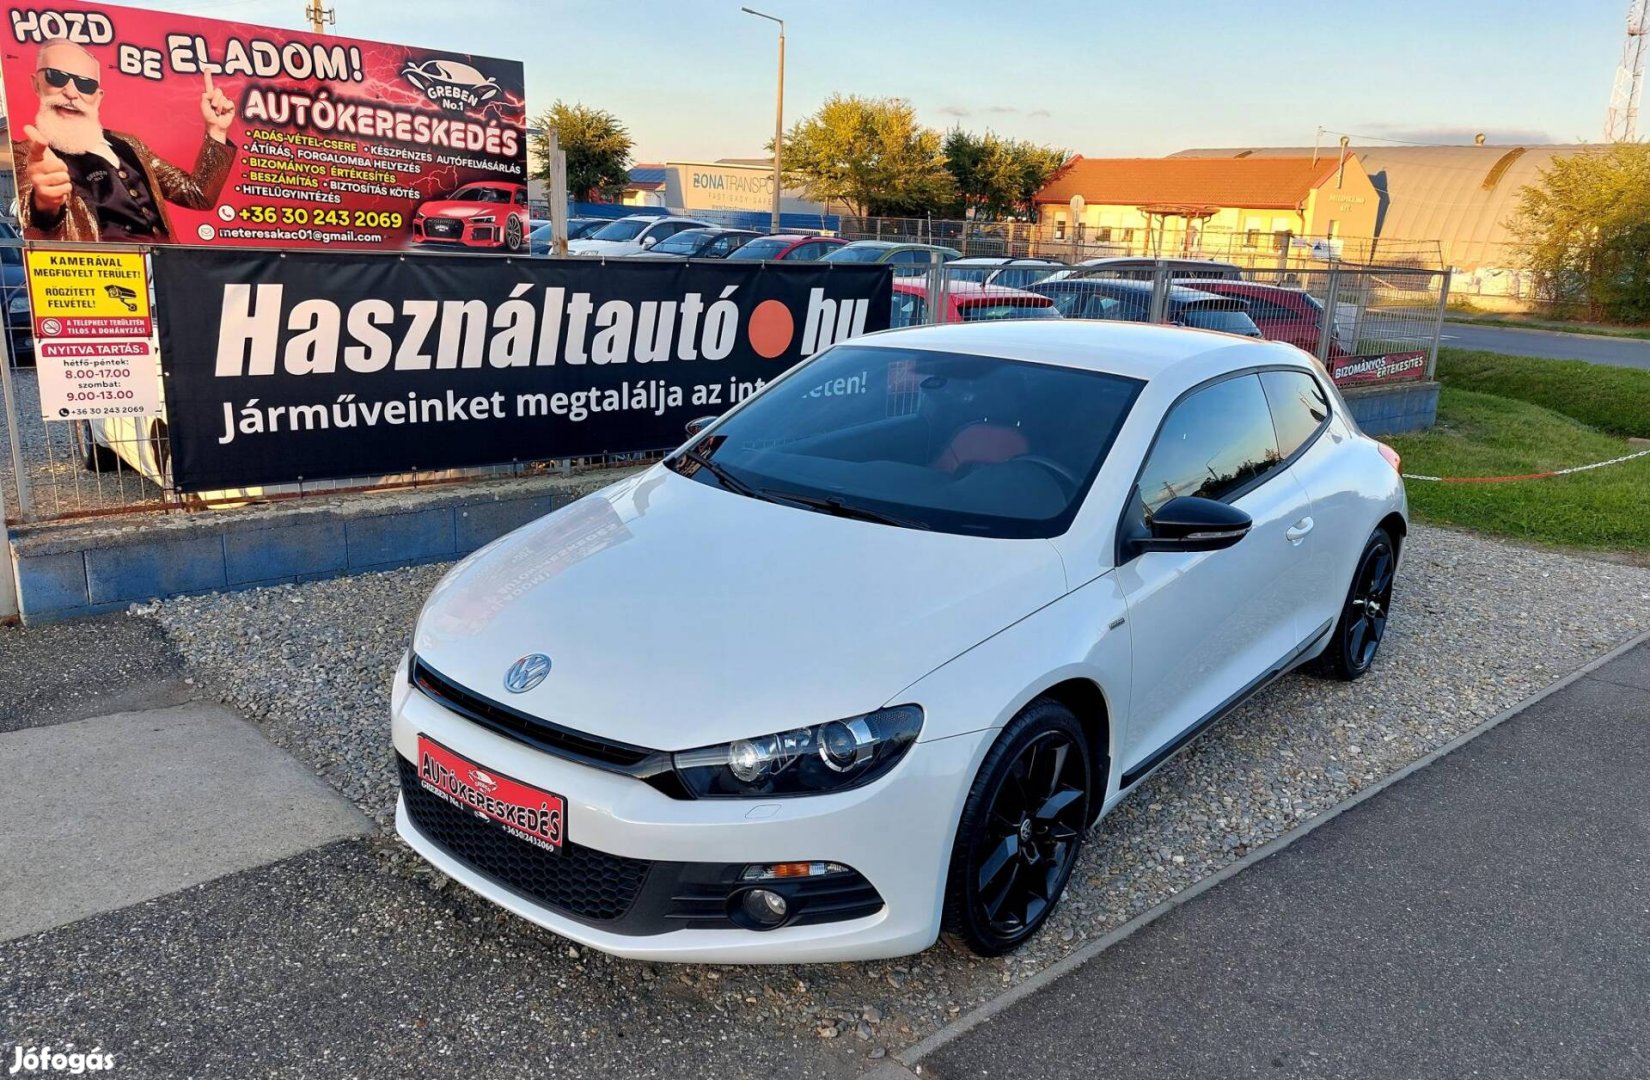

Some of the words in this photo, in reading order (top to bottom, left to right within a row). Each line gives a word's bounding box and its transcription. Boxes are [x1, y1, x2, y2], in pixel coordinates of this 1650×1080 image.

[11, 10, 113, 44] HOZD
[120, 44, 163, 79] BE
[168, 35, 363, 81] ELADOM!
[427, 86, 479, 107] GREBEN
[442, 98, 464, 111] No.1
[244, 90, 518, 157] AUTÓKERESKEDÉS
[253, 129, 357, 152] ADÁS-VÉTEL-CSERE
[250, 142, 294, 158] ÁTÍRÁS,
[298, 149, 371, 167] FORGALOMBA
[374, 159, 421, 173] HELYEZÉS
[370, 145, 432, 163] KÉSZPÉNZES
[436, 154, 521, 175] AUTÓFELVÁSÁRLÁS
[250, 158, 326, 175] BIZOMÁNYOS
[331, 166, 396, 183] ÉRTÉKESÍTÉS
[243, 185, 341, 203] HITELÜGYINTÉZÉS
[250, 172, 319, 187] BESZÁMÍTÁS
[330, 181, 388, 196] BIZTOSÍTÁS
[390, 186, 420, 199] KÖTÉS
[239, 206, 277, 223] +36
[282, 208, 308, 224] 30
[313, 210, 350, 226] 243
[354, 211, 402, 228] 2069
[219, 228, 382, 243] meteresakac01@gmail.com
[50, 255, 123, 267] KAMERÁVAL
[33, 268, 93, 278] MEGFIGYELT
[98, 268, 141, 279] TERÜLET!
[45, 285, 96, 296] RÖGZÍTETT
[48, 298, 96, 308] FELVÉTEL!
[98, 326, 146, 334] DOHÁNYZÁS!
[47, 345, 95, 356] NYITVA
[96, 343, 144, 354] TARTÁS:
[65, 369, 131, 379] 8.00-17.00
[1335, 356, 1386, 379] BIZOMÁNYOS
[1376, 355, 1424, 378] ÉRTÉKESÍTÉS
[66, 390, 134, 401] 9.00-13.00
[78, 381, 121, 389] szombat:
[218, 390, 506, 445] Járműveinket
[517, 379, 683, 422] megtalálja
[691, 383, 722, 404] az
[423, 751, 562, 842] AUTÓKERESKEDÉS
